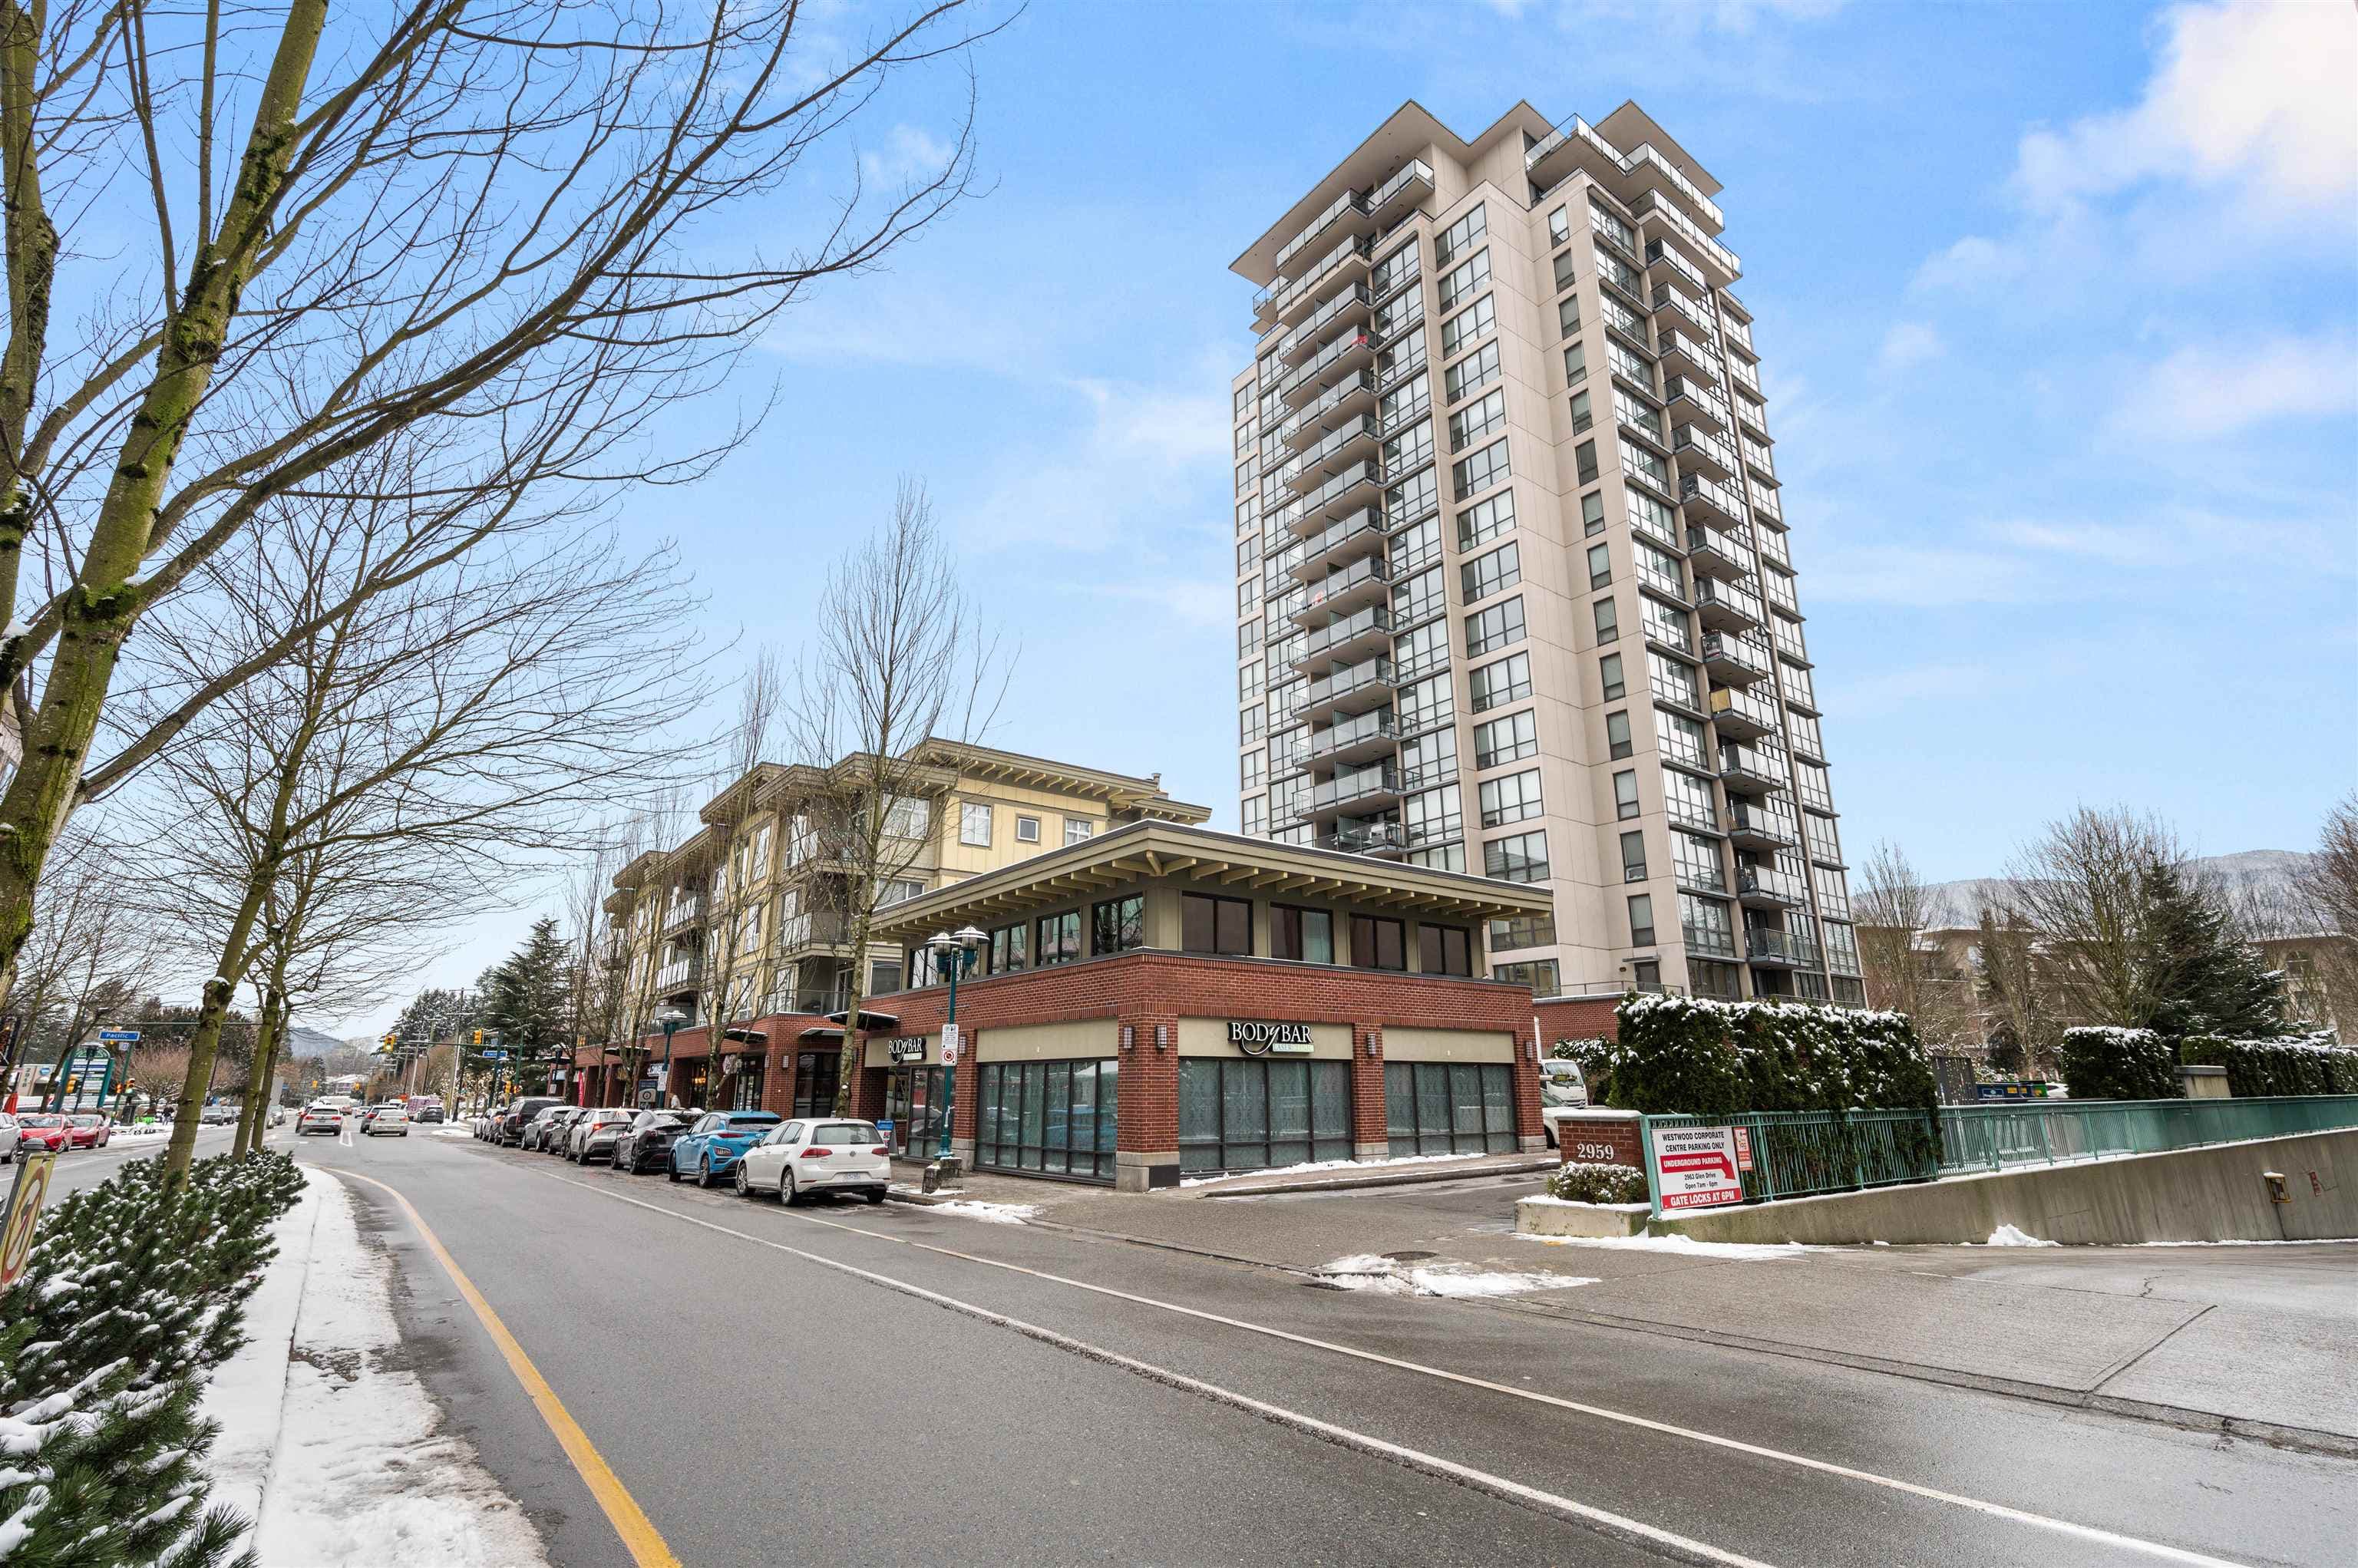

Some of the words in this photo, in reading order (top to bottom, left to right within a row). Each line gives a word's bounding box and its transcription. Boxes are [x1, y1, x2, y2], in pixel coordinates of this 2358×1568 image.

[1662, 1132, 1693, 1141] WESTWOOD
[1694, 1131, 1725, 1140] CORPORATE
[1577, 1143, 1614, 1160] 2959
[1665, 1144, 1687, 1152] CENTRE
[1688, 1142, 1711, 1151] PARKING
[1712, 1141, 1725, 1150] ONLY
[1663, 1158, 1701, 1167] UNDERGROUND
[1702, 1156, 1722, 1165] PARKING
[1670, 1195, 1689, 1207] GATE
[1689, 1193, 1712, 1204] LOCKS
[1712, 1192, 1720, 1202] AT
[1721, 1190, 1735, 1200] 6PM
